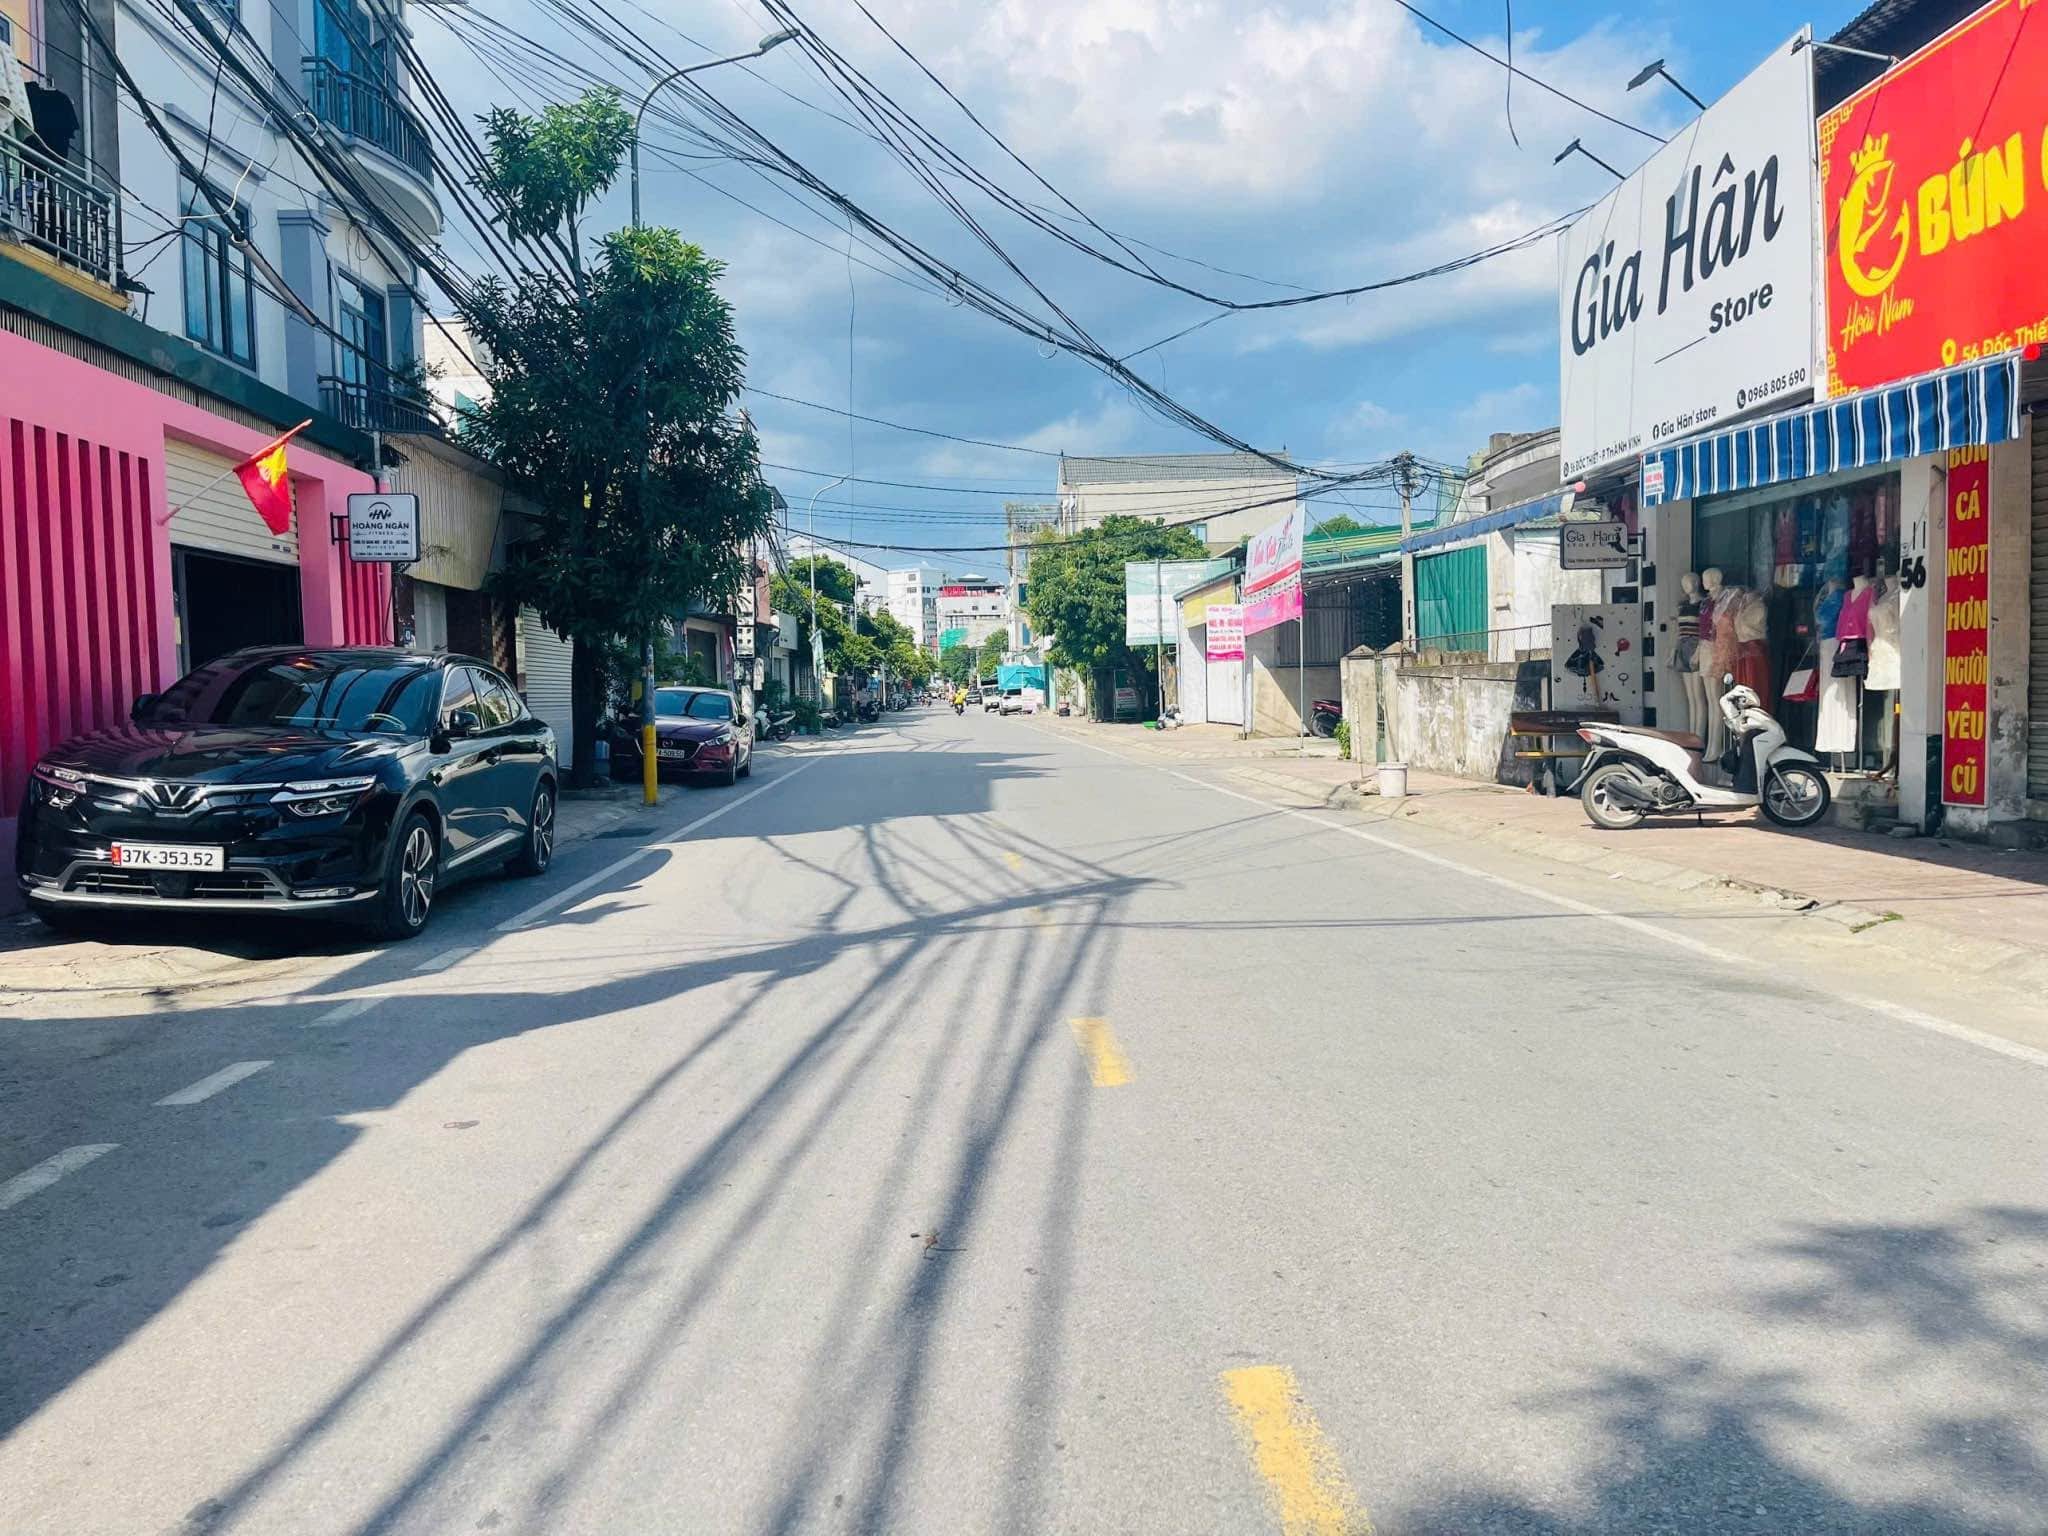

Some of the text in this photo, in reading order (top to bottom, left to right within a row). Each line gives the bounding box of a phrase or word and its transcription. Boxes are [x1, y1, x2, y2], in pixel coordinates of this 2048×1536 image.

[1918, 131, 2024, 256] BÚN
[1571, 152, 1784, 356] Gia Hân
[1877, 283, 1914, 336] Nam
[1748, 367, 1806, 402] 0968 805 690
[1661, 420, 1675, 436] Gia
[1955, 480, 1981, 521] CÁ
[352, 521, 383, 530] HOÀNG
[1901, 555, 1926, 590] 56
[1947, 543, 1988, 582] NGỌT
[1946, 596, 1988, 631] HƠN
[1945, 647, 1988, 685] NGƯỜI
[1947, 701, 1984, 740] YÊU
[1951, 757, 1978, 794] CŨ
[122, 850, 213, 866] 37K-353.52
